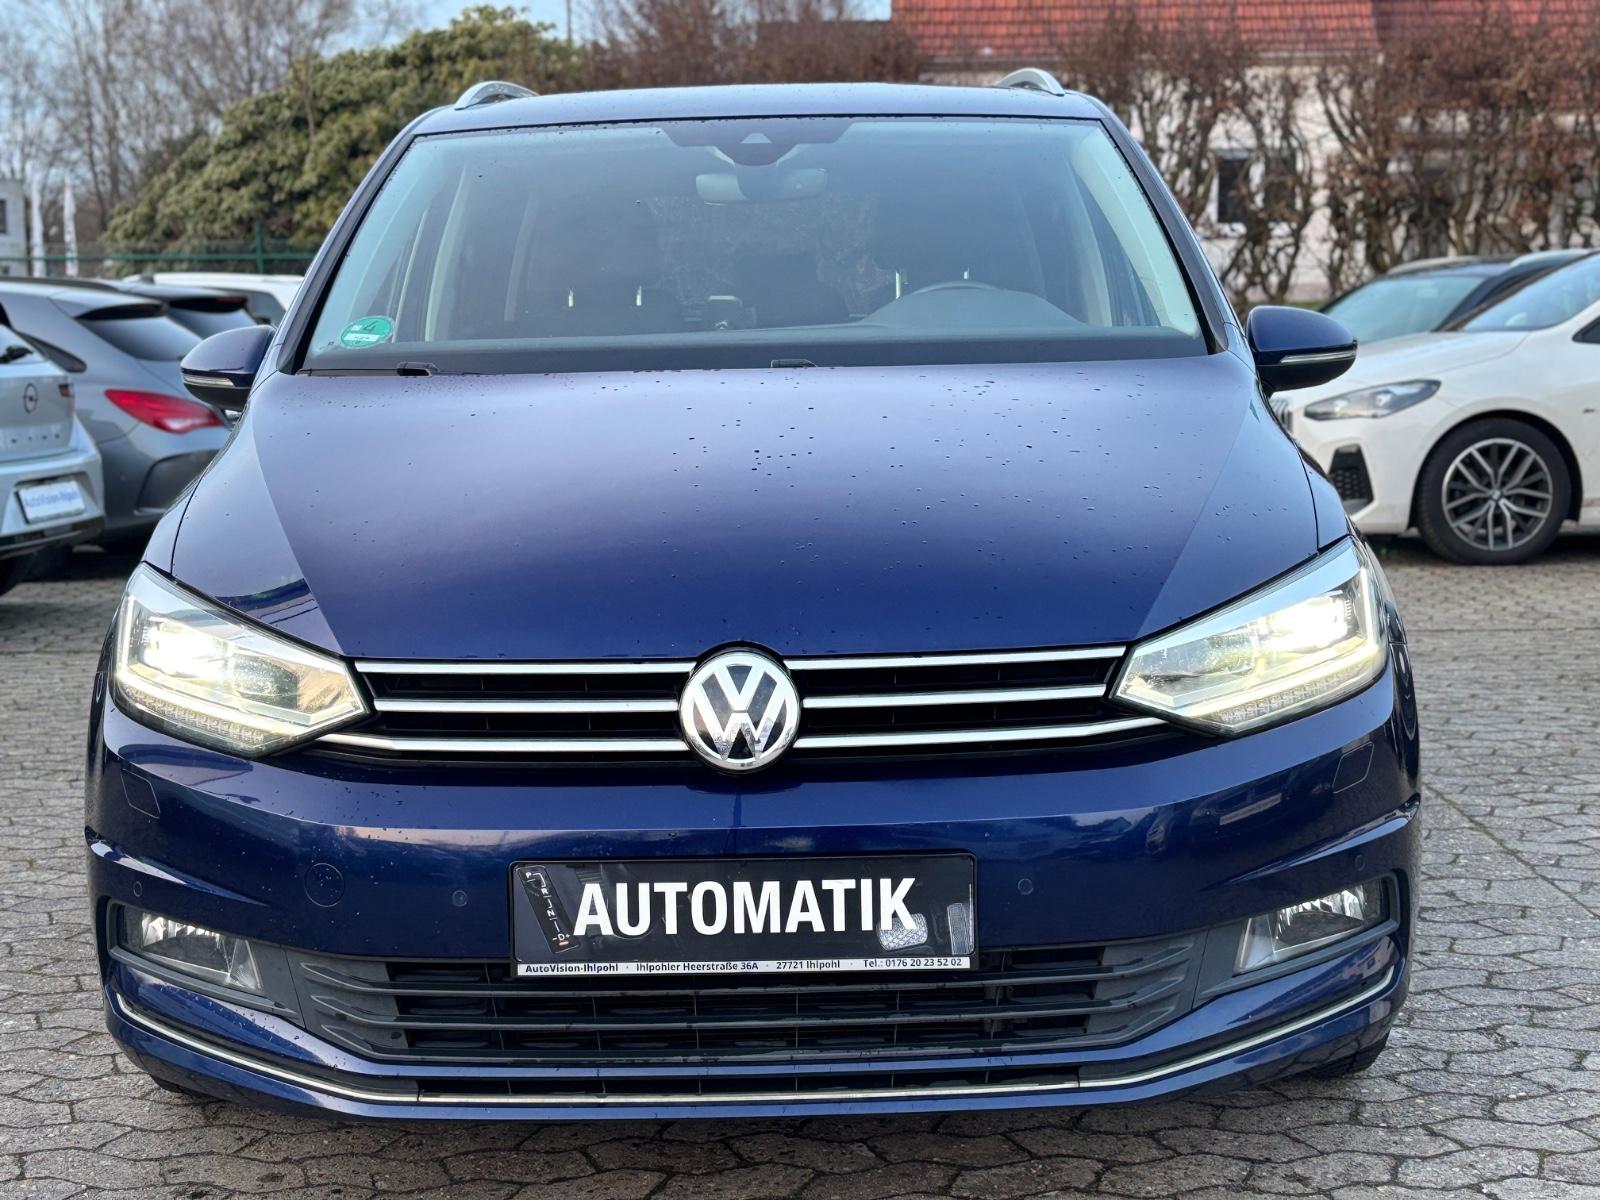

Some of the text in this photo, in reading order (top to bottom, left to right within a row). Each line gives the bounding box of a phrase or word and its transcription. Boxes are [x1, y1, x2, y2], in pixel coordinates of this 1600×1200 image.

[541, 887, 549, 895] R
[546, 909, 555, 917] N
[573, 878, 916, 936] AUTOMATIK
[525, 963, 619, 974] AutoVision-Ihlpohl
[636, 962, 681, 973] Ihlpohler
[683, 961, 738, 971] Heerstraße
[740, 962, 759, 970] 36A
[777, 961, 804, 970] 27721
[806, 960, 840, 970] Ihlpohl
[864, 960, 883, 968] Tel.:
[886, 959, 907, 968] 0176
[910, 959, 921, 967] 20
[924, 959, 935, 967] 23
[951, 958, 962, 967] 02
